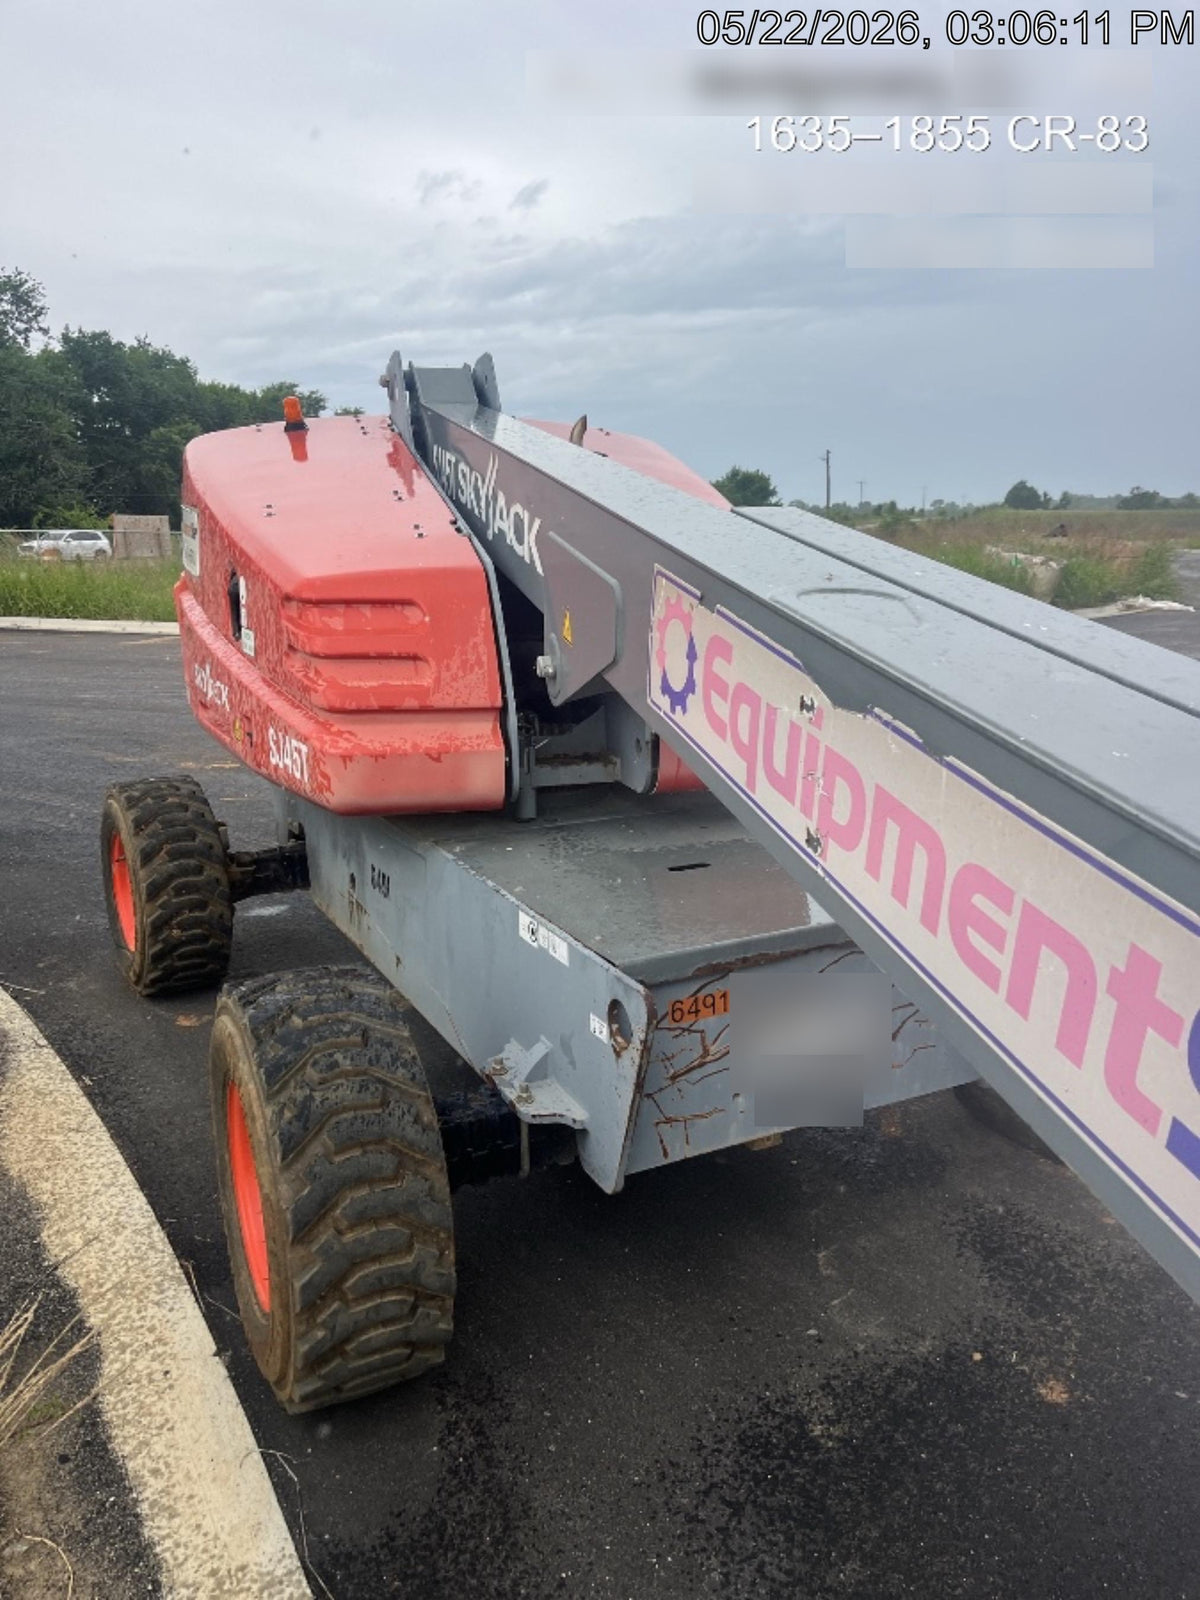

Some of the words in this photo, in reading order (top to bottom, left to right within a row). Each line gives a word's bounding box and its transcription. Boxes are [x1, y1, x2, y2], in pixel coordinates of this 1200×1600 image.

[458, 450, 544, 576] SKYJACK
[268, 725, 308, 783] SJ45T
[671, 991, 728, 1023] 6491
